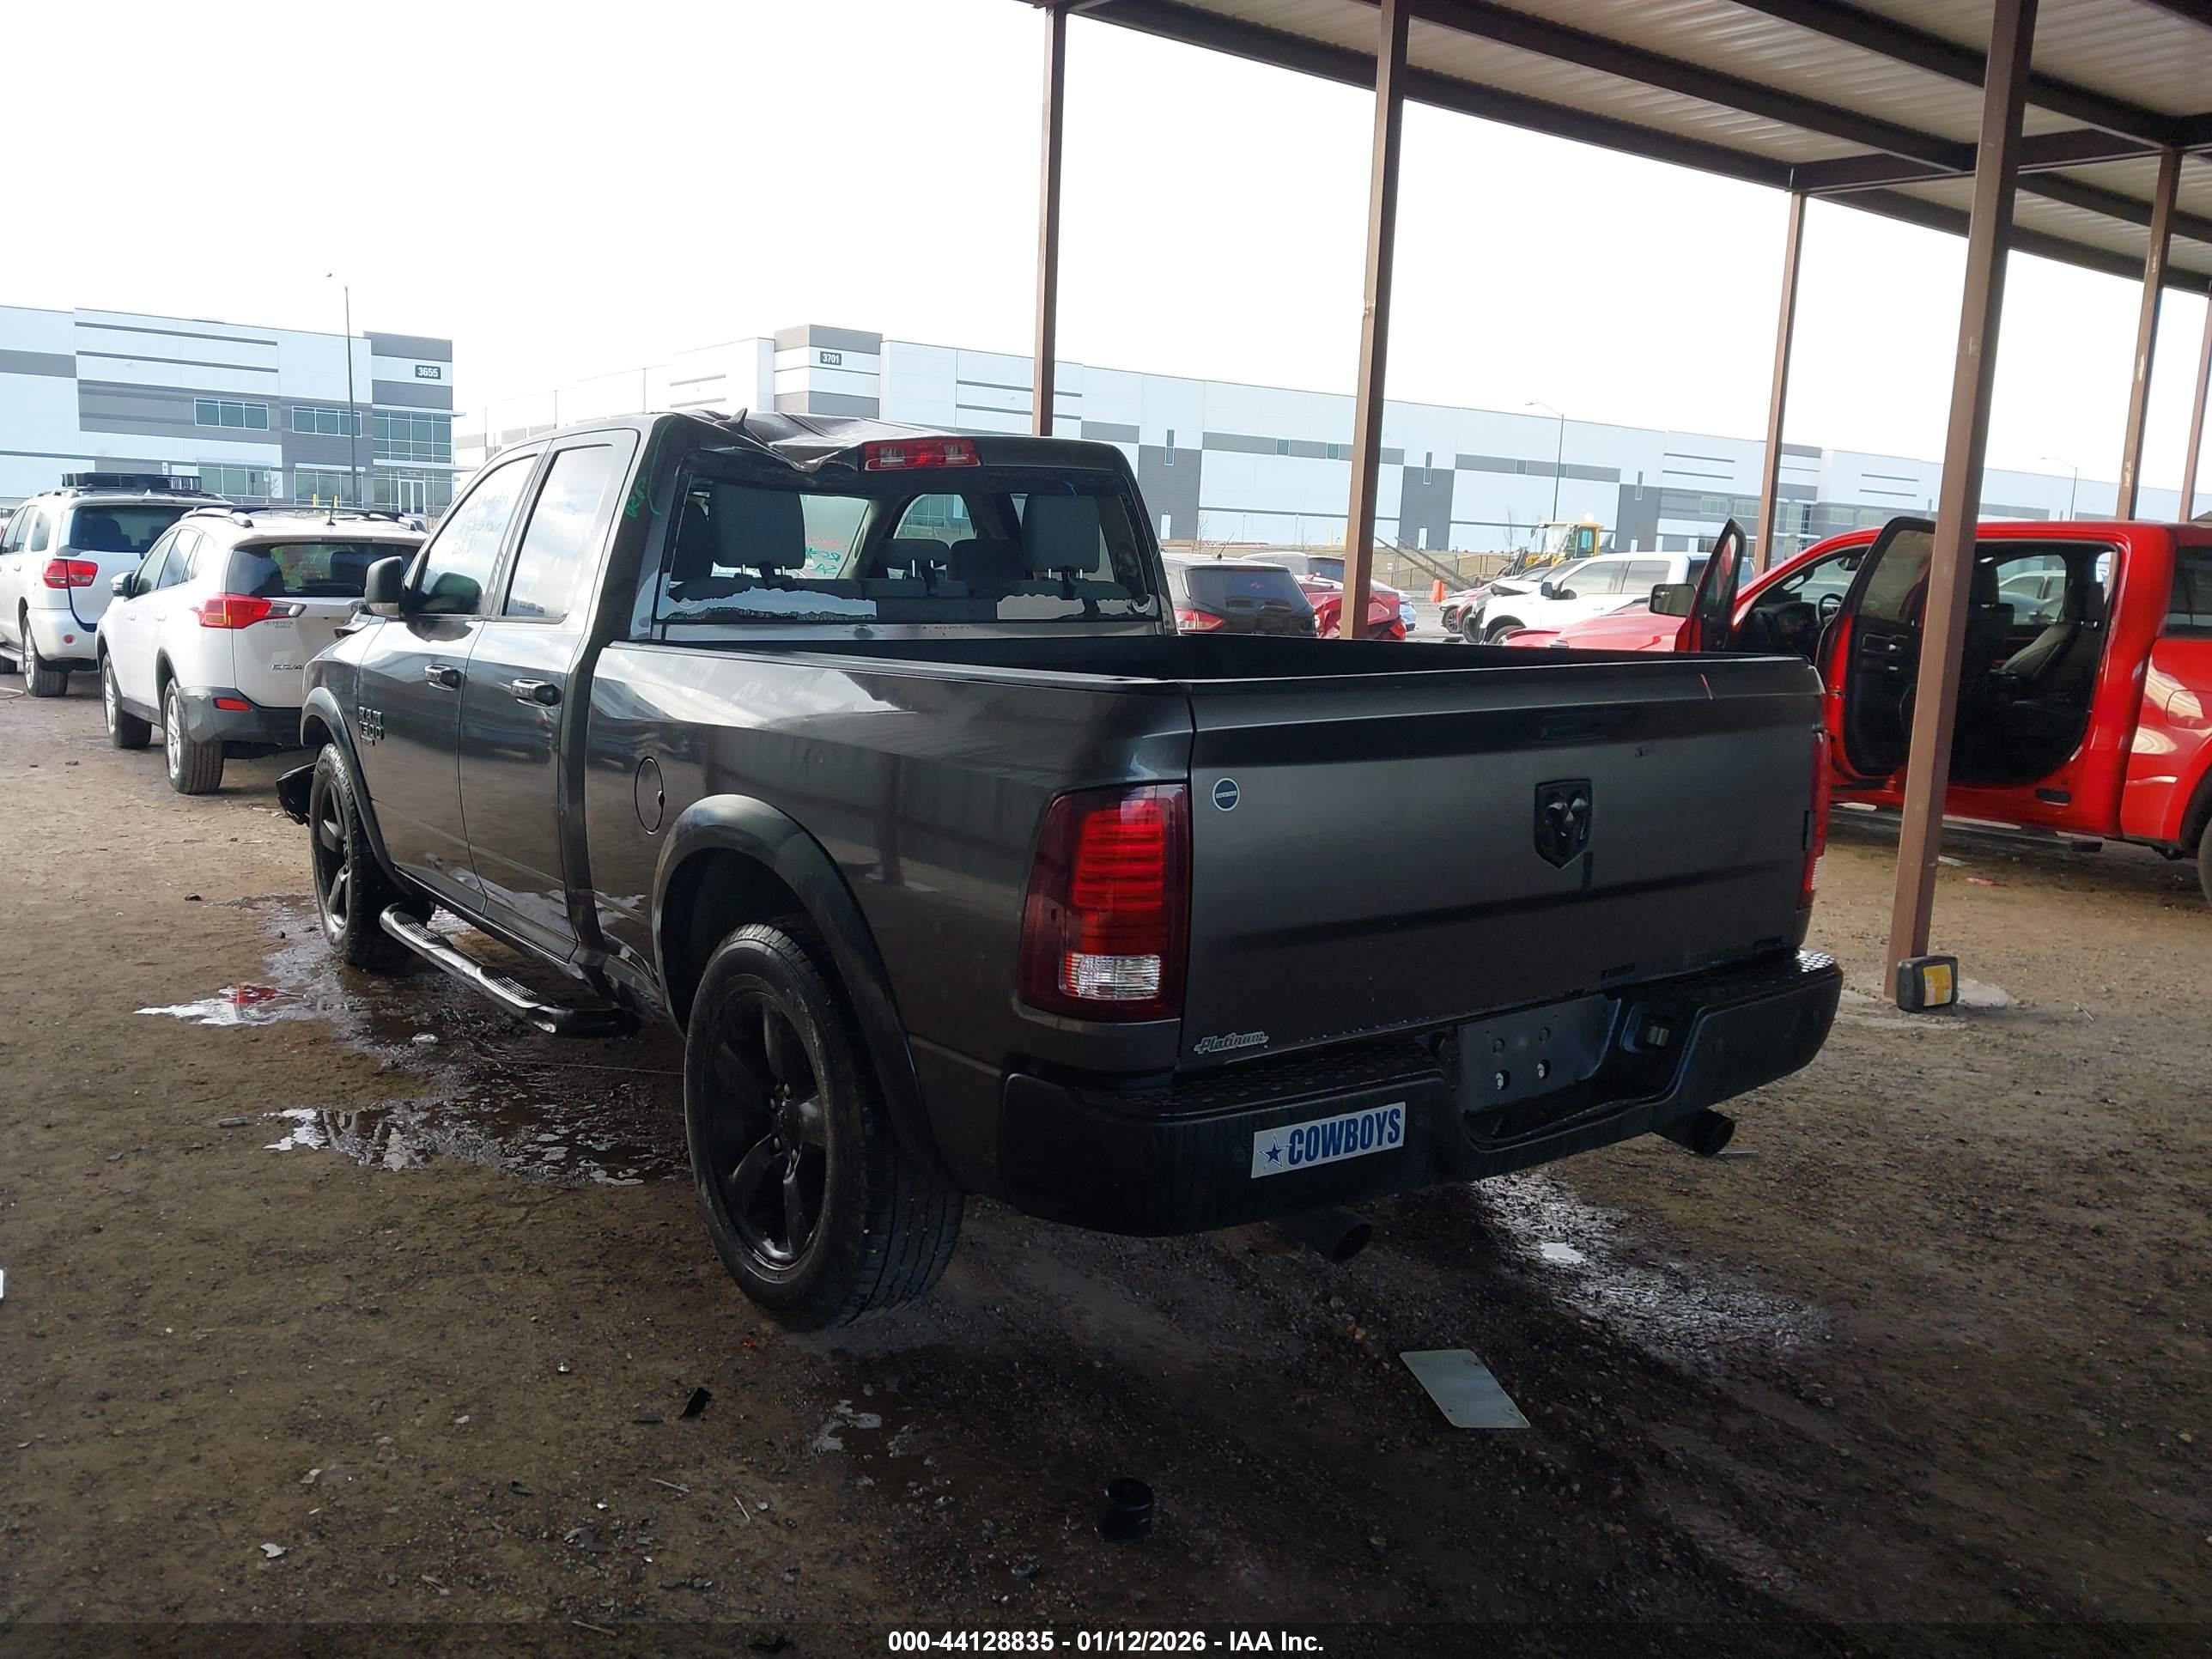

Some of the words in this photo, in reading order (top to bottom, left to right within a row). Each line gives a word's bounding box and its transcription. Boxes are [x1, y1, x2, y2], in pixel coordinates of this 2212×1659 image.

[823, 353, 839, 364] 3701
[417, 367, 438, 377] 3655
[1287, 1108, 1401, 1165] COWBOYS
